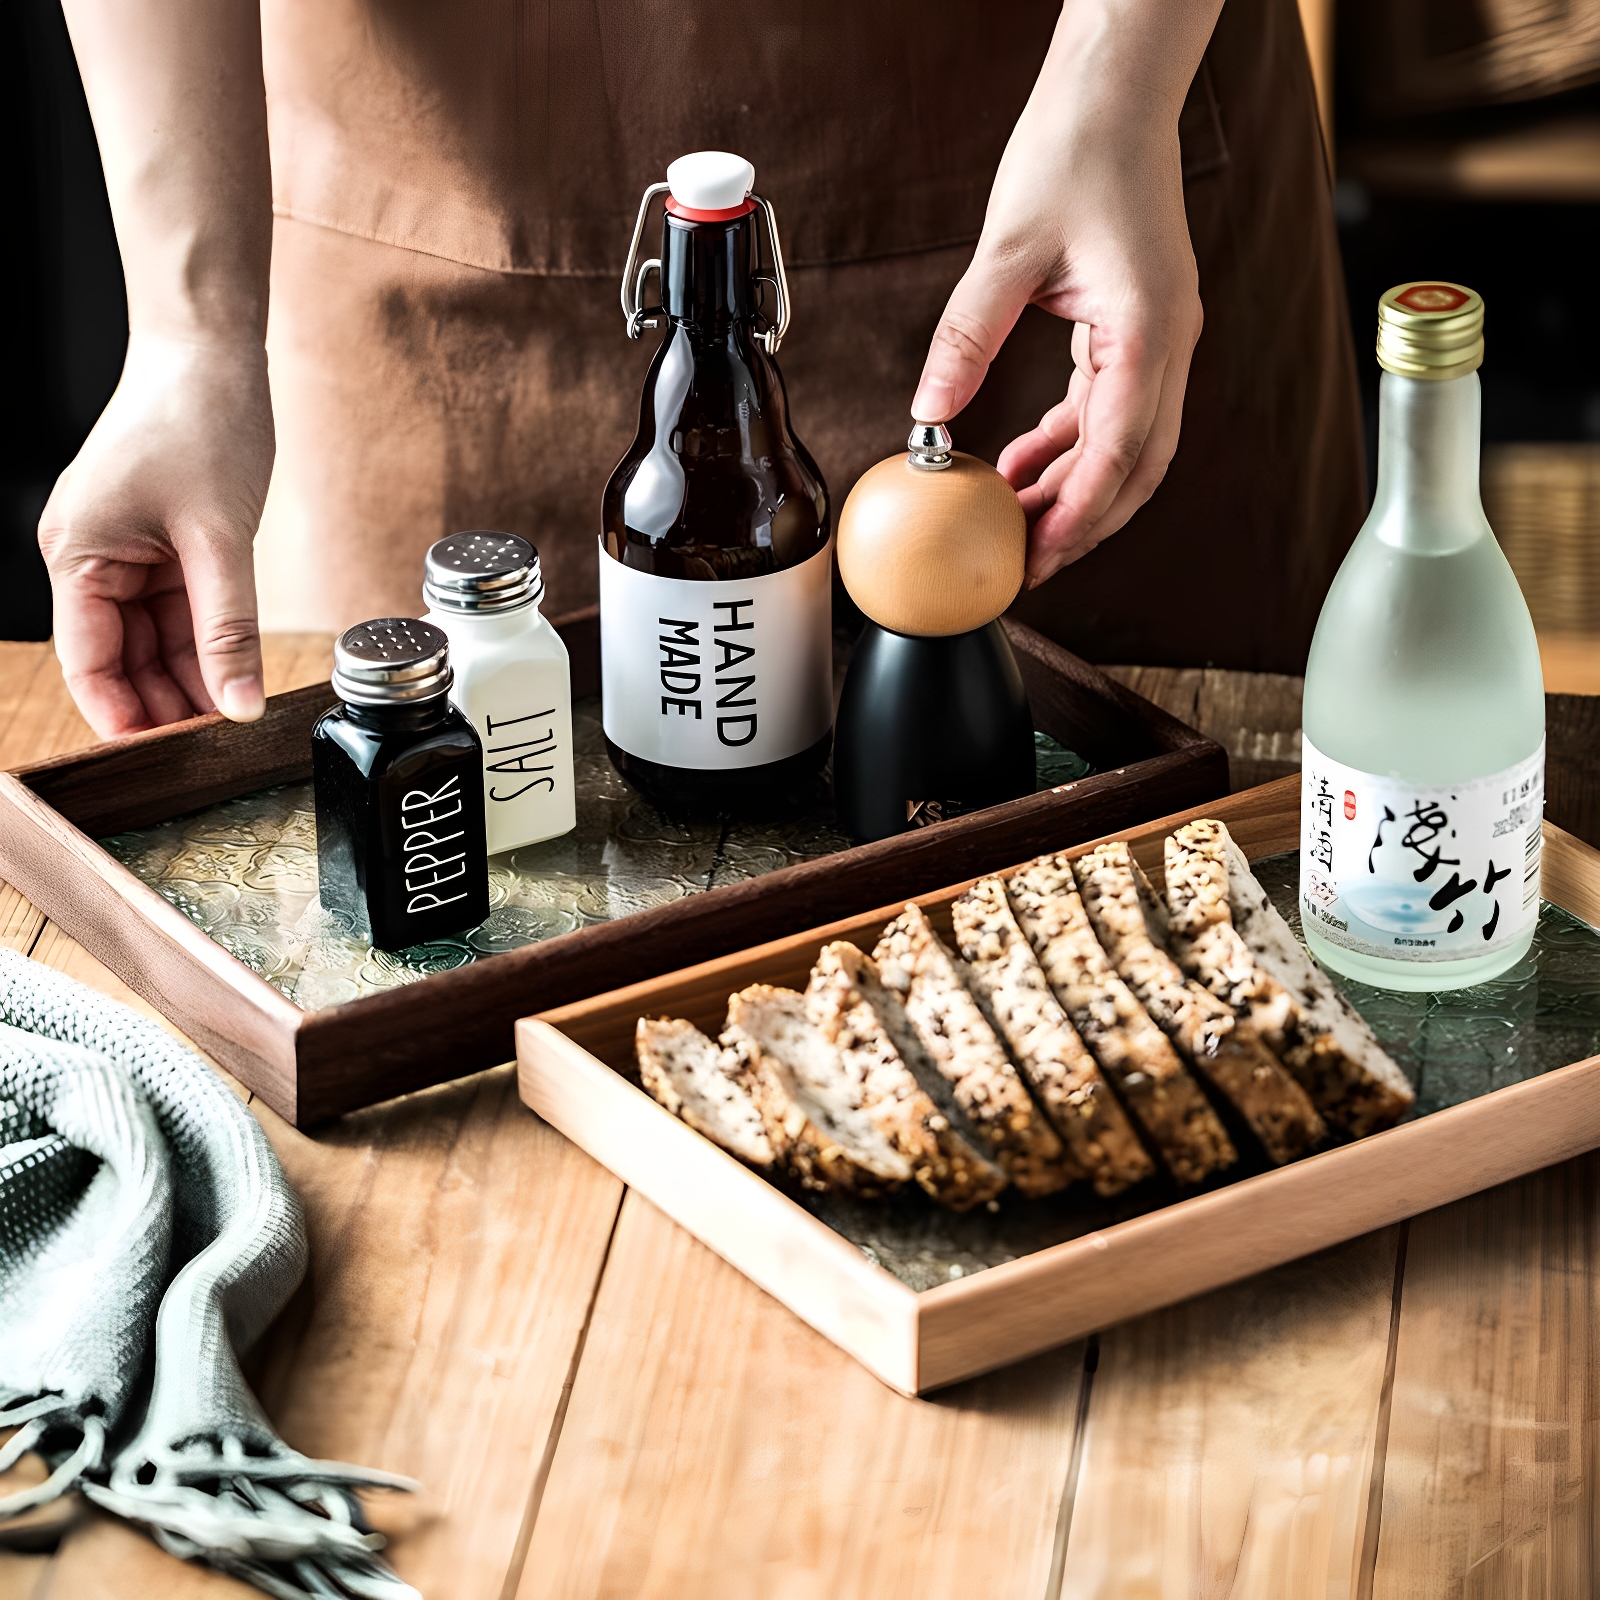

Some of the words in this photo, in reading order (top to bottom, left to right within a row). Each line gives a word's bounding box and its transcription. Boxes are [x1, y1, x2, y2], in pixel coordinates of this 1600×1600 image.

[658, 617, 702, 720] MADE
[713, 599, 758, 747] HAND
[486, 708, 557, 802] SALT
[401, 775, 468, 913] PEPPER
